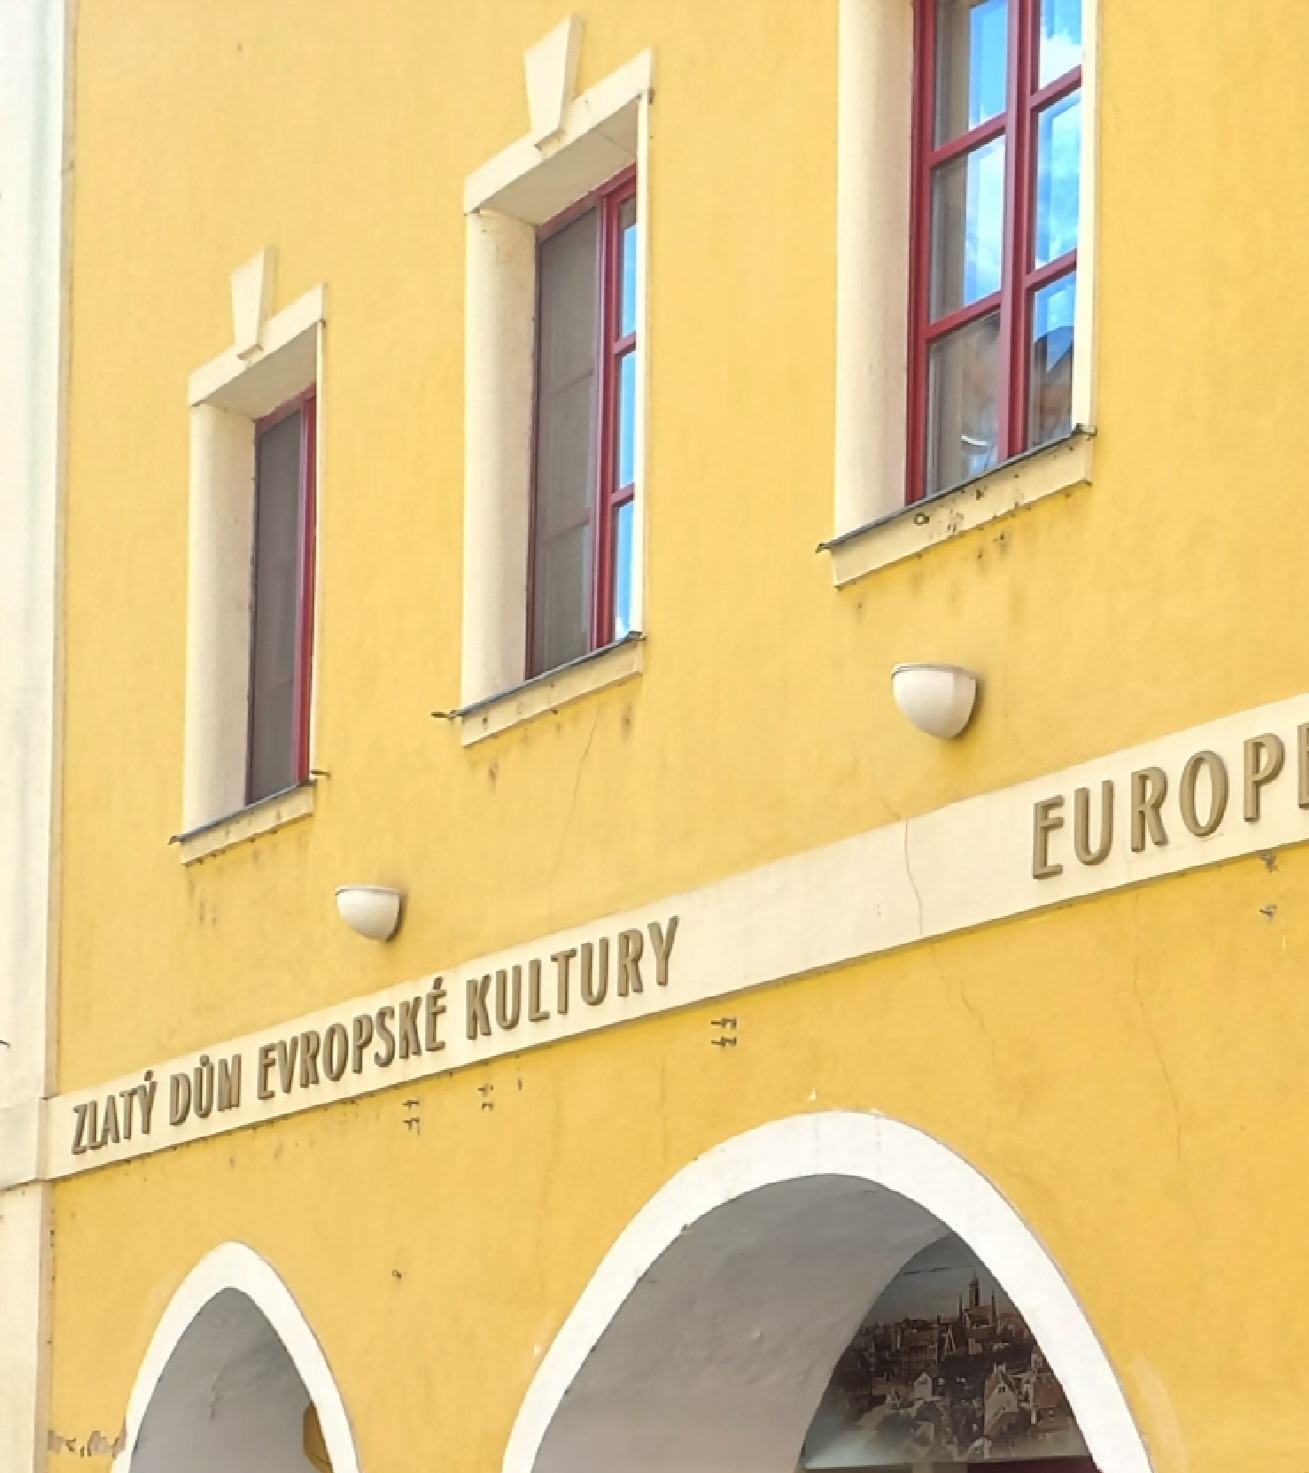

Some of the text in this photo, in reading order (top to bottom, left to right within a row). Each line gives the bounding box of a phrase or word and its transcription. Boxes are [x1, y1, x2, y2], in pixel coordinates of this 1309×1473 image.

[71, 915, 680, 1156] ZLATÝ DŮM EVROPSKÉ KULTURY
